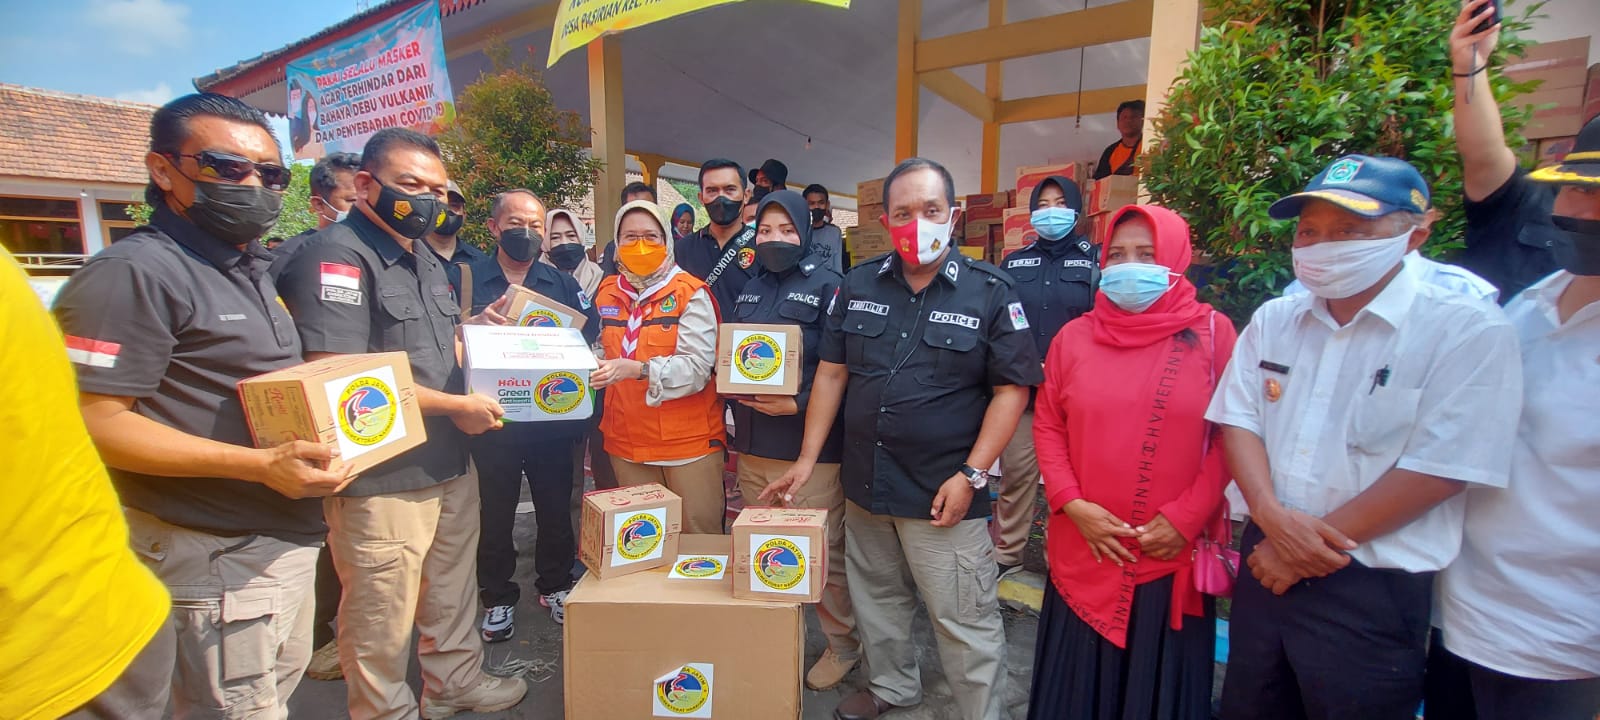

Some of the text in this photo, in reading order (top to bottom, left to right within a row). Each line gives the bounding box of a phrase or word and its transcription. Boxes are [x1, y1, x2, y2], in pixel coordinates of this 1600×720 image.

[316, 41, 422, 89] PAKAI SELALU MASKER
[319, 63, 427, 108] AGAR TERHINDAR DARI
[319, 83, 435, 126] BAHAYA DEBU VULKANIK
[315, 128, 335, 144] DAN
[336, 114, 397, 138] PENYEBARAN
[787, 292, 820, 307] POLICE
[933, 313, 976, 328] POLICE
[746, 335, 766, 343] POLDA
[345, 378, 369, 395] POLDA
[498, 388, 530, 397] Green
[628, 514, 661, 530] POLDA JATIM
[766, 540, 803, 560] POLDA JATIM
